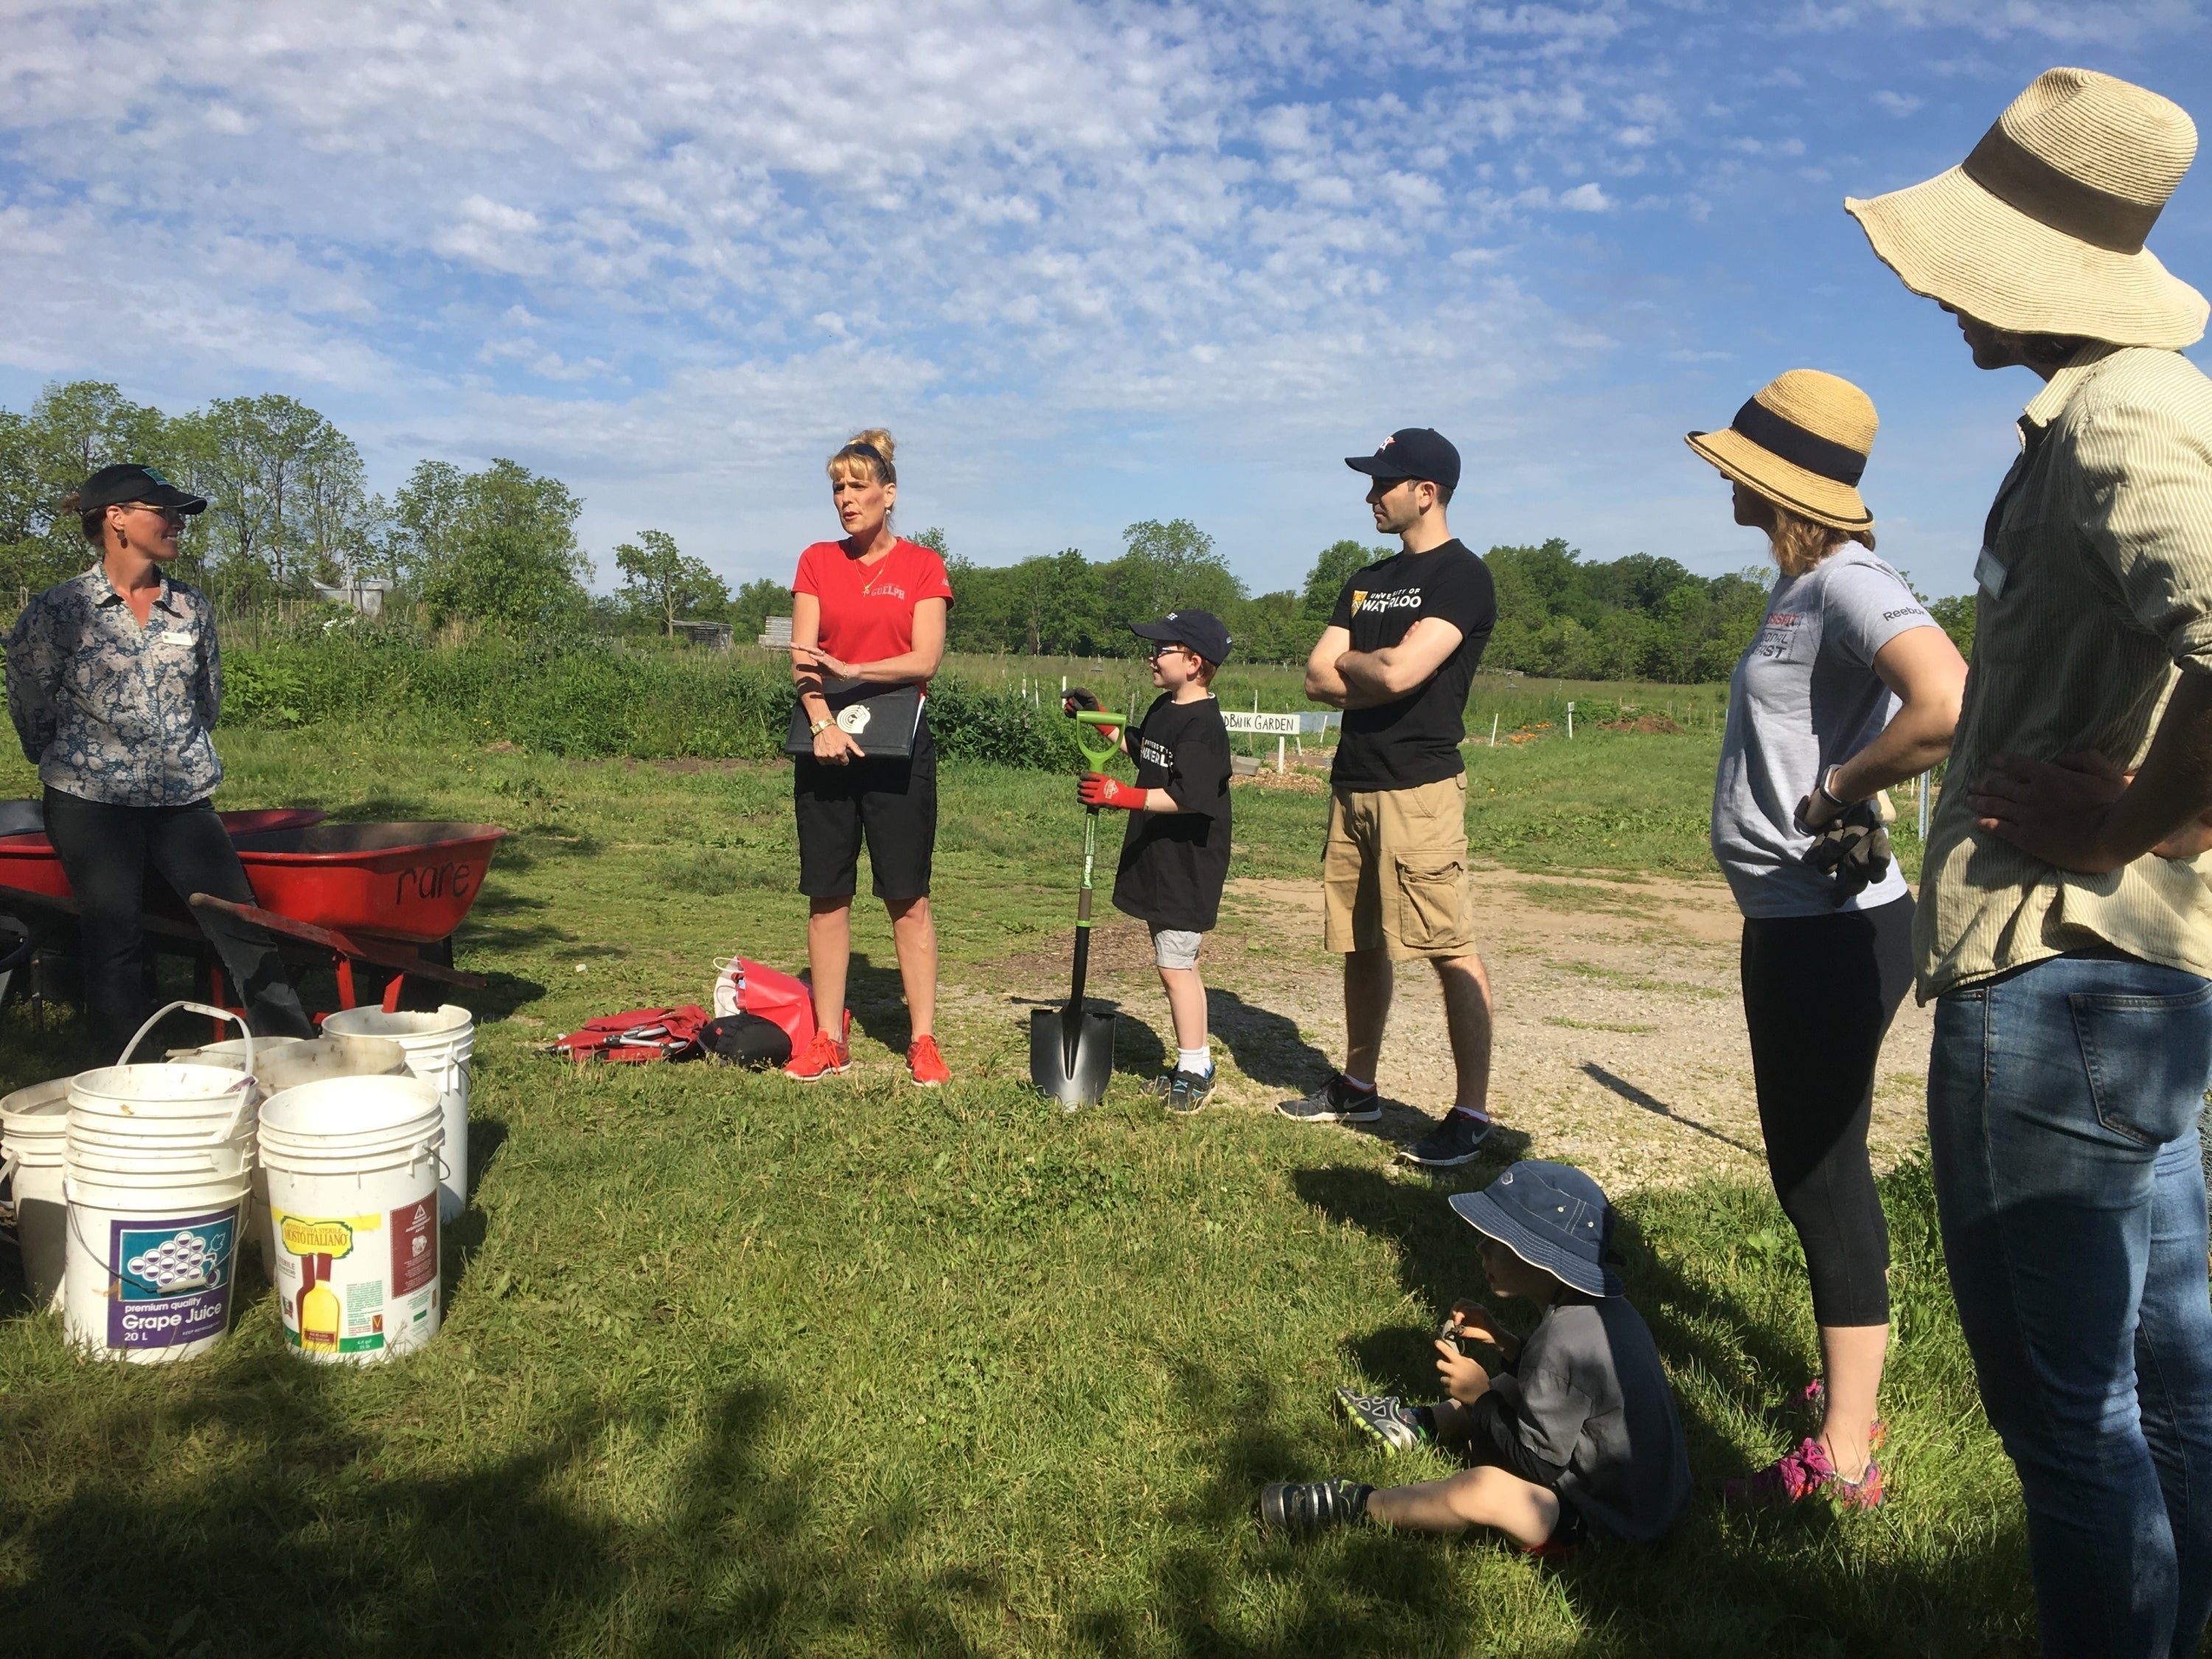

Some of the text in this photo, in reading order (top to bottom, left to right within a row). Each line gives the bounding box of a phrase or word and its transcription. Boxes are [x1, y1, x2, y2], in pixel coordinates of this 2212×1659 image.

[870, 585, 905, 600] GUELPH
[1362, 595, 1422, 613] WATRLOO
[1254, 714, 1294, 731] GARDEN
[396, 861, 470, 906] rare
[125, 1297, 202, 1313] premium quality
[122, 1302, 222, 1332] Grape Juice
[124, 1332, 147, 1341] 20 L
